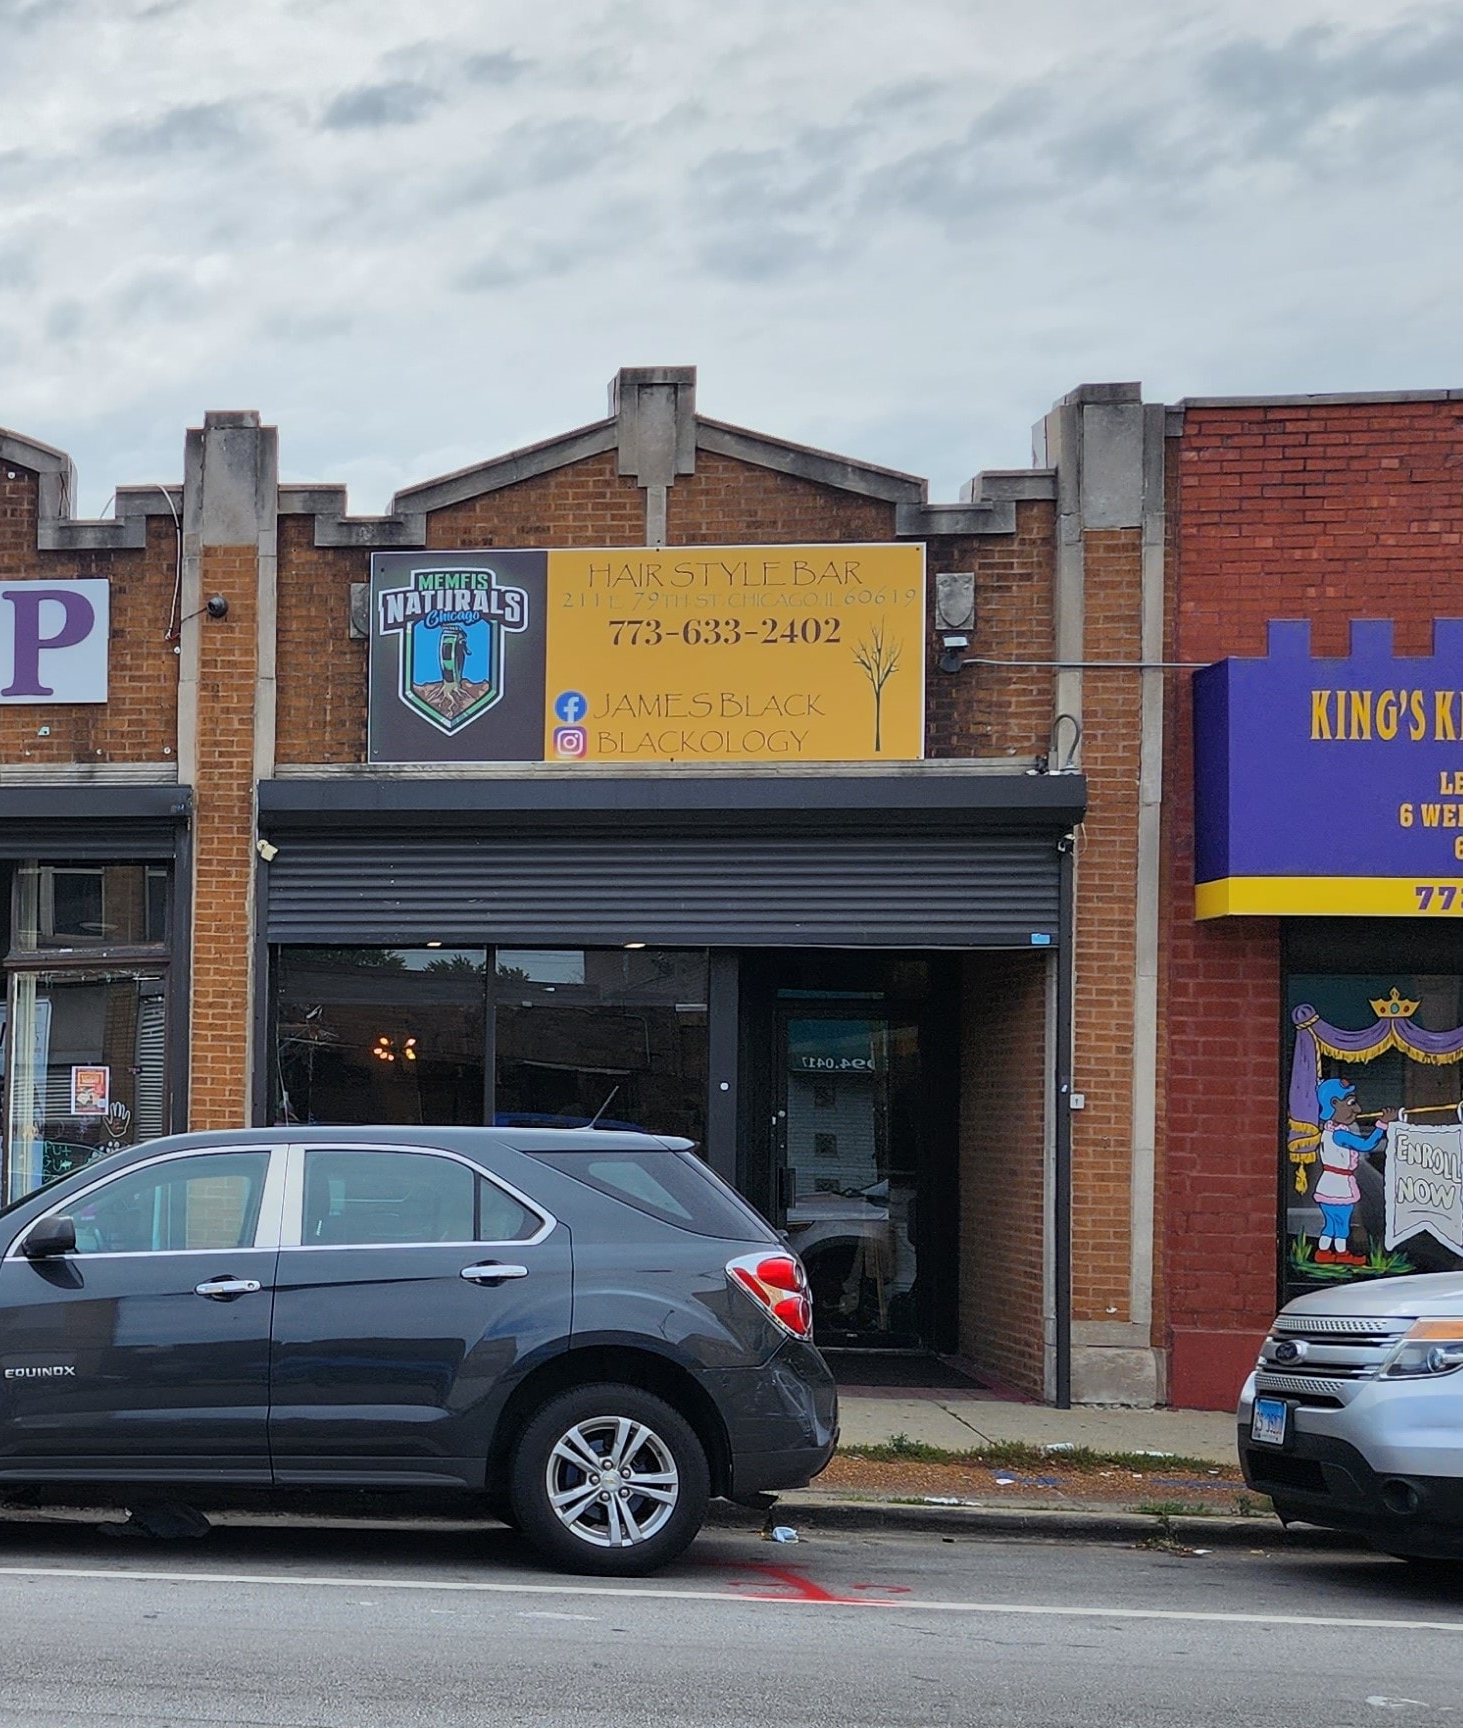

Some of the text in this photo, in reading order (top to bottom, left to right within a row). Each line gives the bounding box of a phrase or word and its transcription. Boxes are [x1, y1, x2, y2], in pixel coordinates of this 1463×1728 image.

[418, 573, 488, 591] MEMFIS
[588, 560, 863, 588] HAIR STYLE BAR
[386, 589, 521, 624] NATURALS
[562, 592, 600, 608] 211
[844, 587, 916, 607] 60619
[425, 610, 480, 627] Chicago
[609, 617, 841, 645] 773-633-2402
[593, 692, 826, 719] JAMES BLACK
[1309, 689, 1427, 741] KING'S
[597, 729, 809, 754] BLACKOLOGY
[1399, 803, 1414, 827] 6
[1414, 886, 1463, 911] 77
[1396, 1134, 1462, 1185] ENROLL
[1397, 1176, 1456, 1210] NOW
[4, 1365, 76, 1379] EQUINOX
